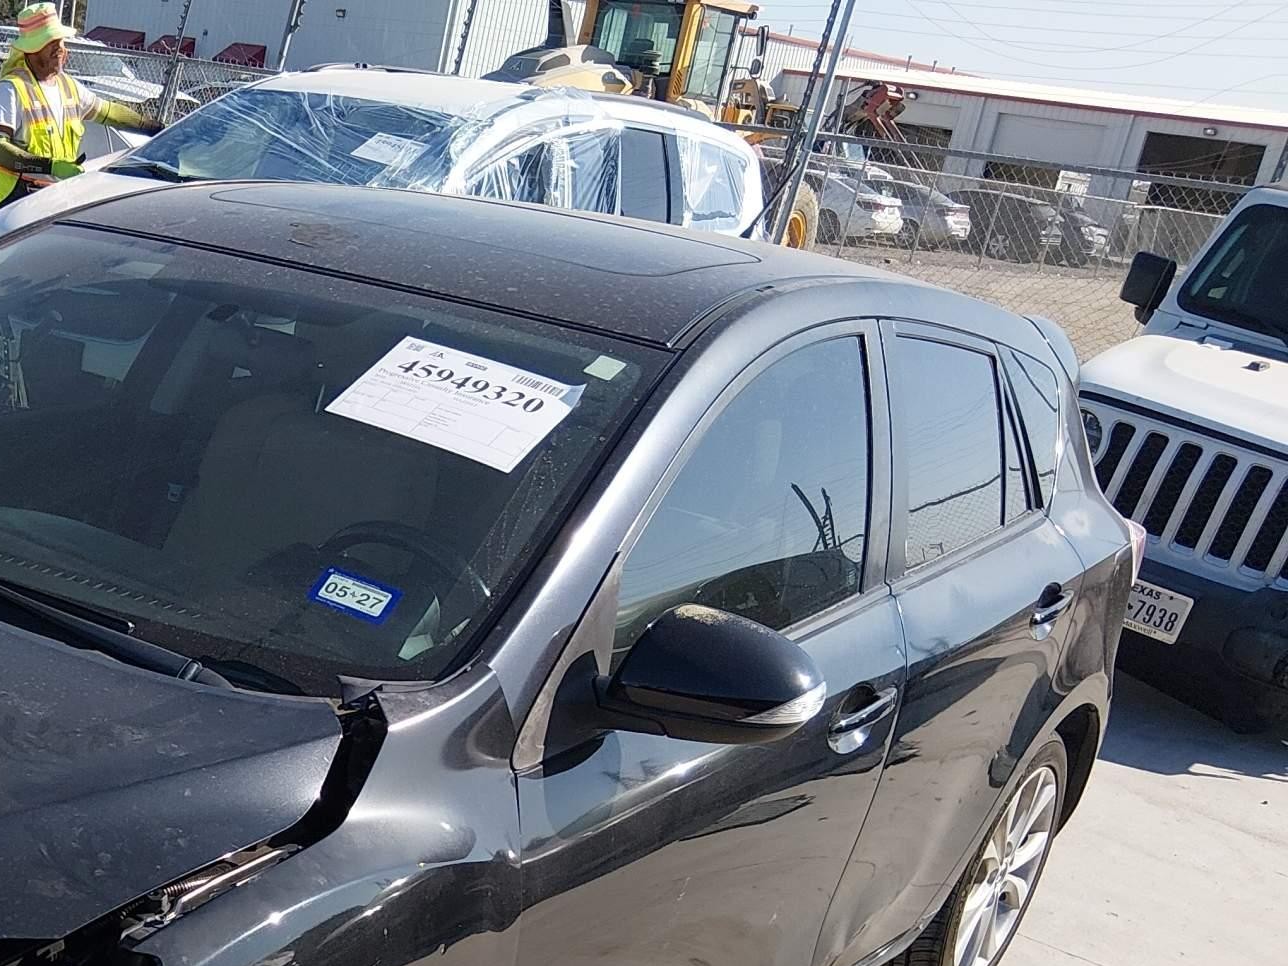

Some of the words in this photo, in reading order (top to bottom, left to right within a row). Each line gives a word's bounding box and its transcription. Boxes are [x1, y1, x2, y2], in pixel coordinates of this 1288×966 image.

[397, 360, 544, 413] 45949320
[1132, 584, 1161, 600] EXAS
[1132, 599, 1179, 632] 7938
